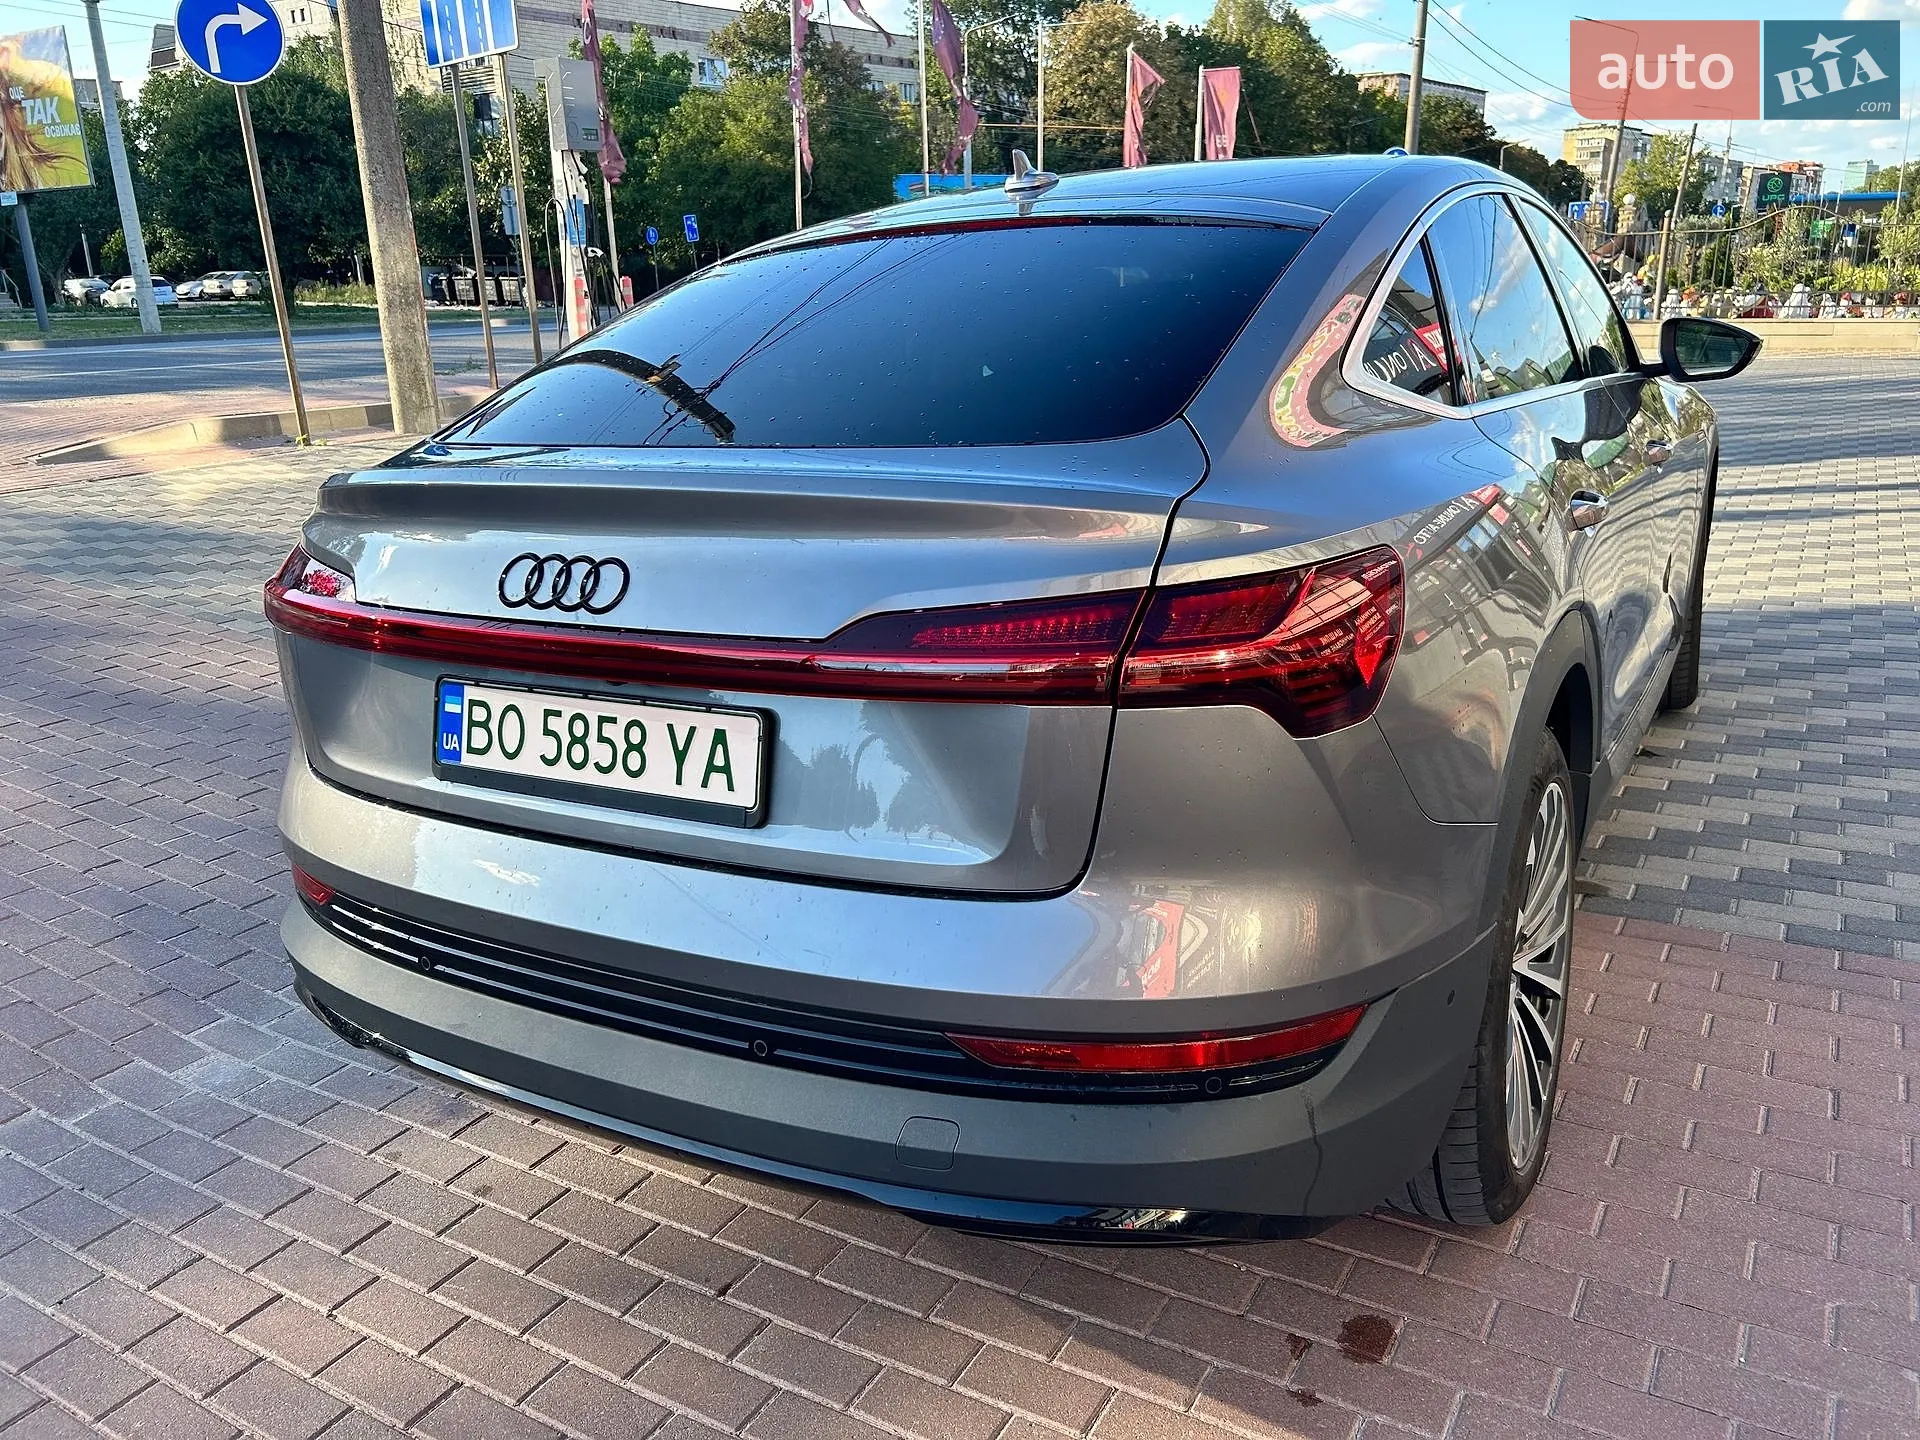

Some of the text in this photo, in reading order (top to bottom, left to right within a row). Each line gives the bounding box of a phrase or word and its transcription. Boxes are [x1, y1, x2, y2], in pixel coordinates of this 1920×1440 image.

[8, 86, 25, 100] ОЦЕ
[21, 96, 61, 125] ТАК
[442, 732, 460, 751] UA
[466, 698, 736, 792] BO 5858 YA
